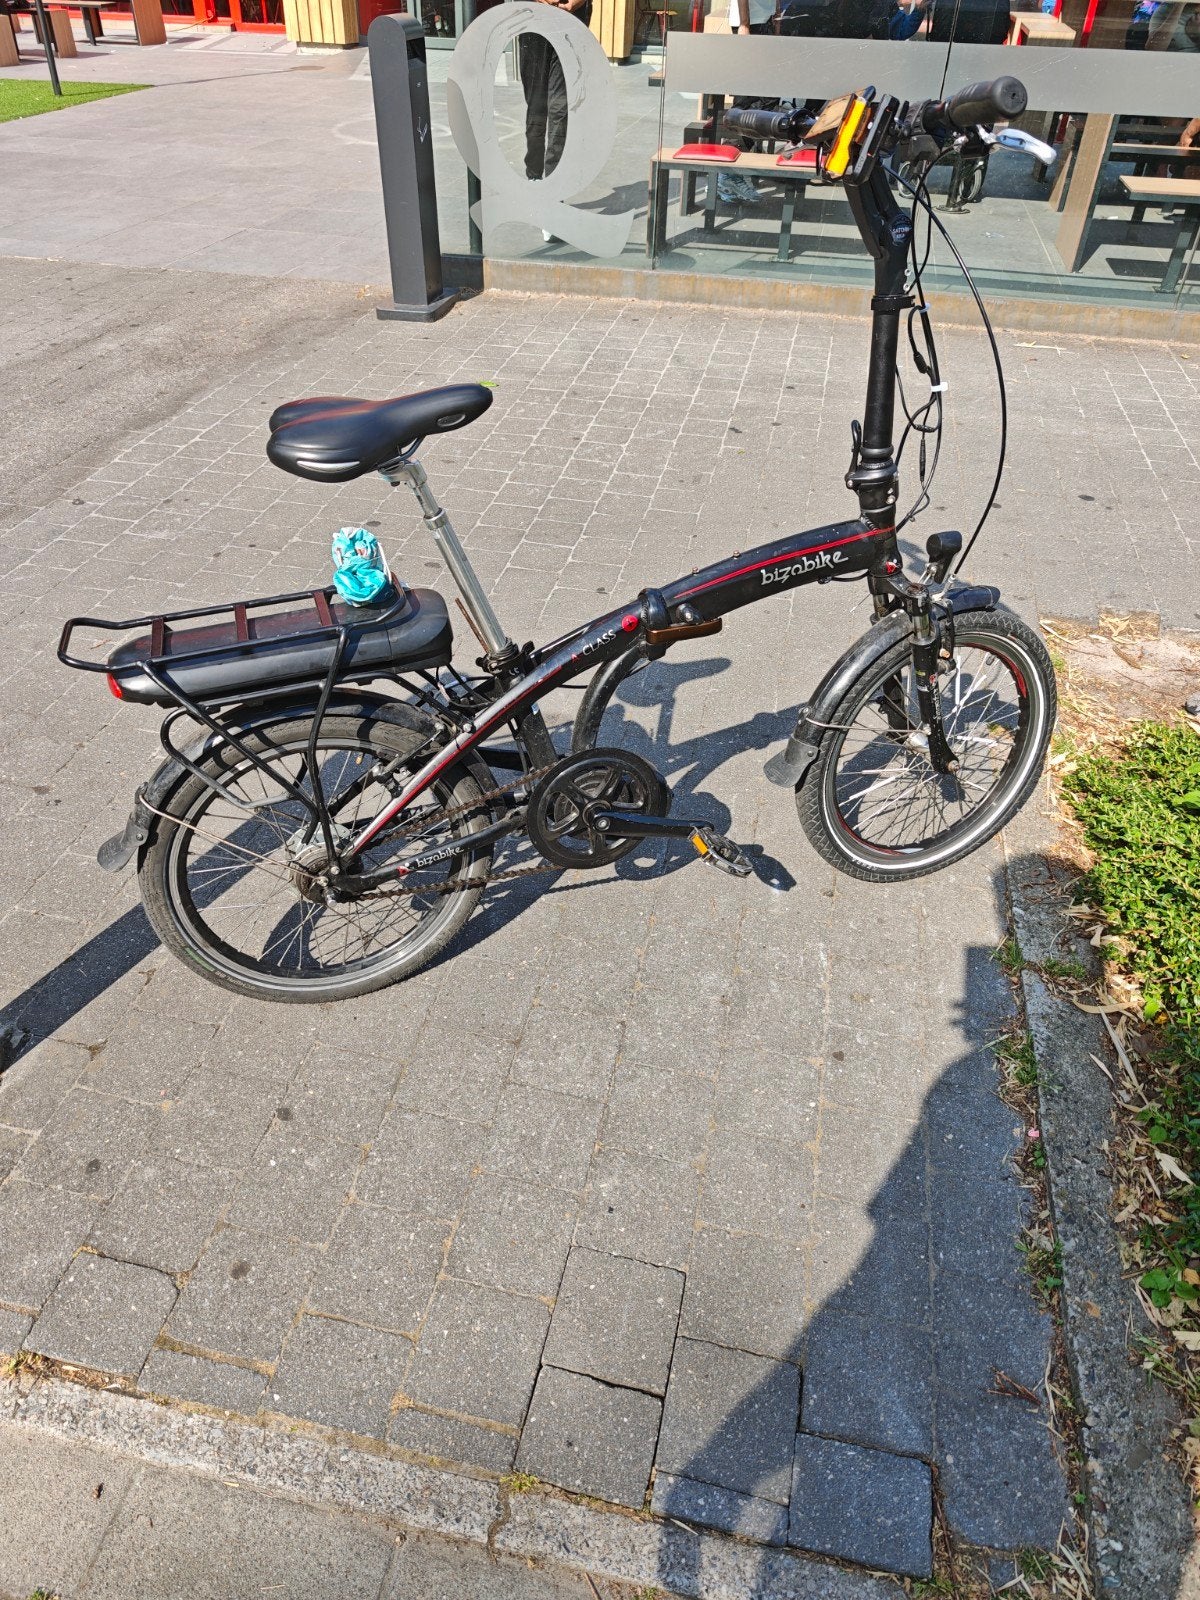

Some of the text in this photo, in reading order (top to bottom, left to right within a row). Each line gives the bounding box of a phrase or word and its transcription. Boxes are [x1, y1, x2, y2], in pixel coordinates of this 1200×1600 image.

[446, 1, 635, 259] Q
[760, 550, 849, 586] bizobike
[582, 629, 617, 656] CLASS
[416, 846, 465, 868] bizobike
